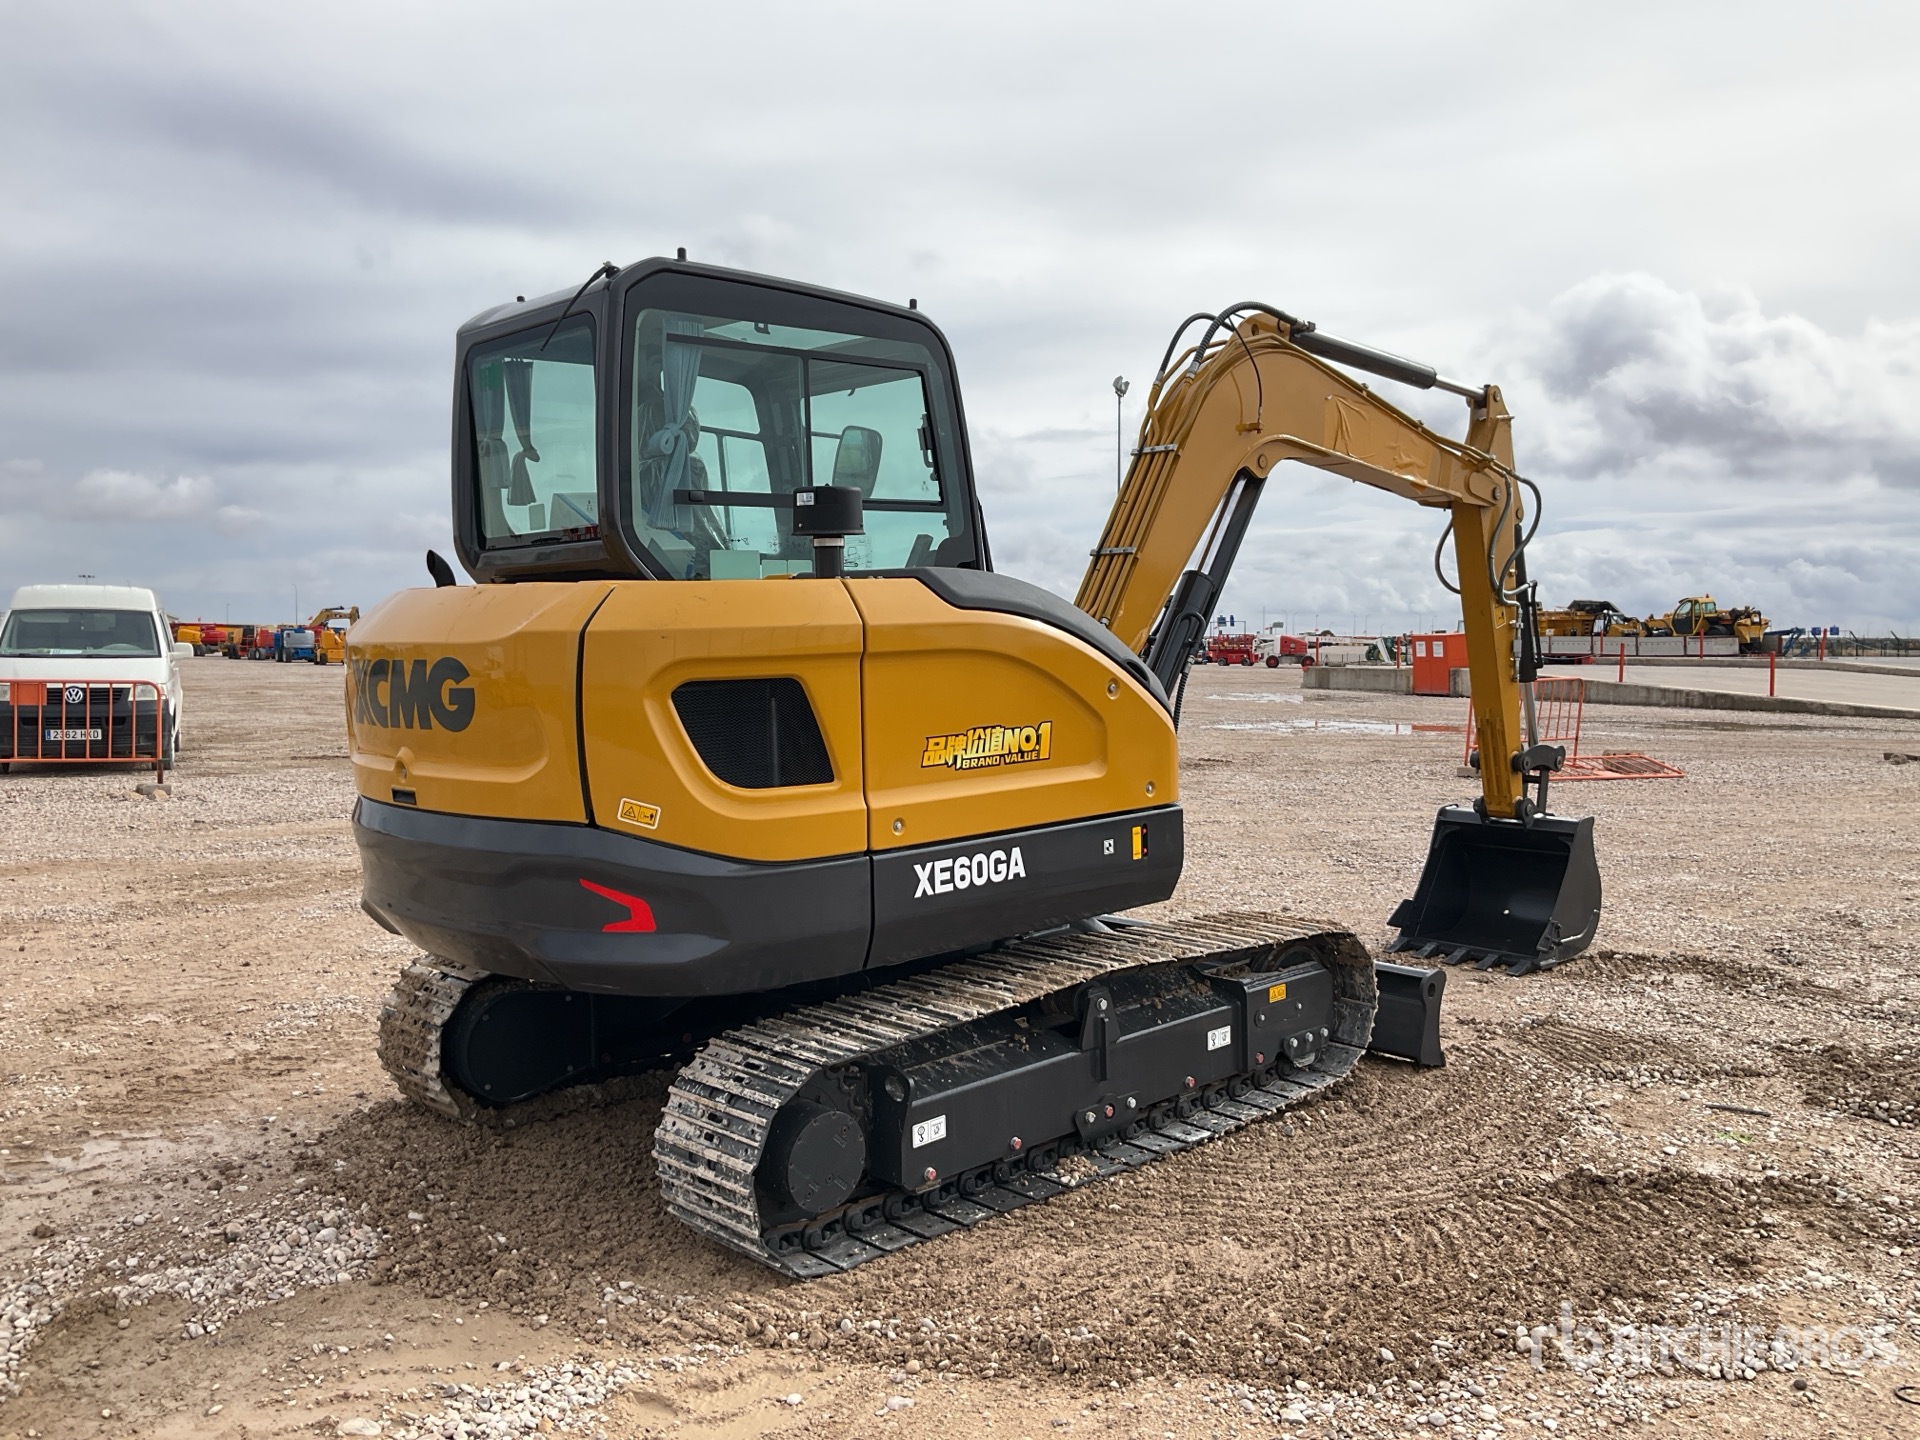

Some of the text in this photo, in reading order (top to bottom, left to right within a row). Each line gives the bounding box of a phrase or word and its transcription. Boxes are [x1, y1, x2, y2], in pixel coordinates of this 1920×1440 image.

[351, 656, 475, 732] XCMG
[962, 750, 1038, 769] BRAND VALUE
[913, 846, 1026, 898] XE60GA
